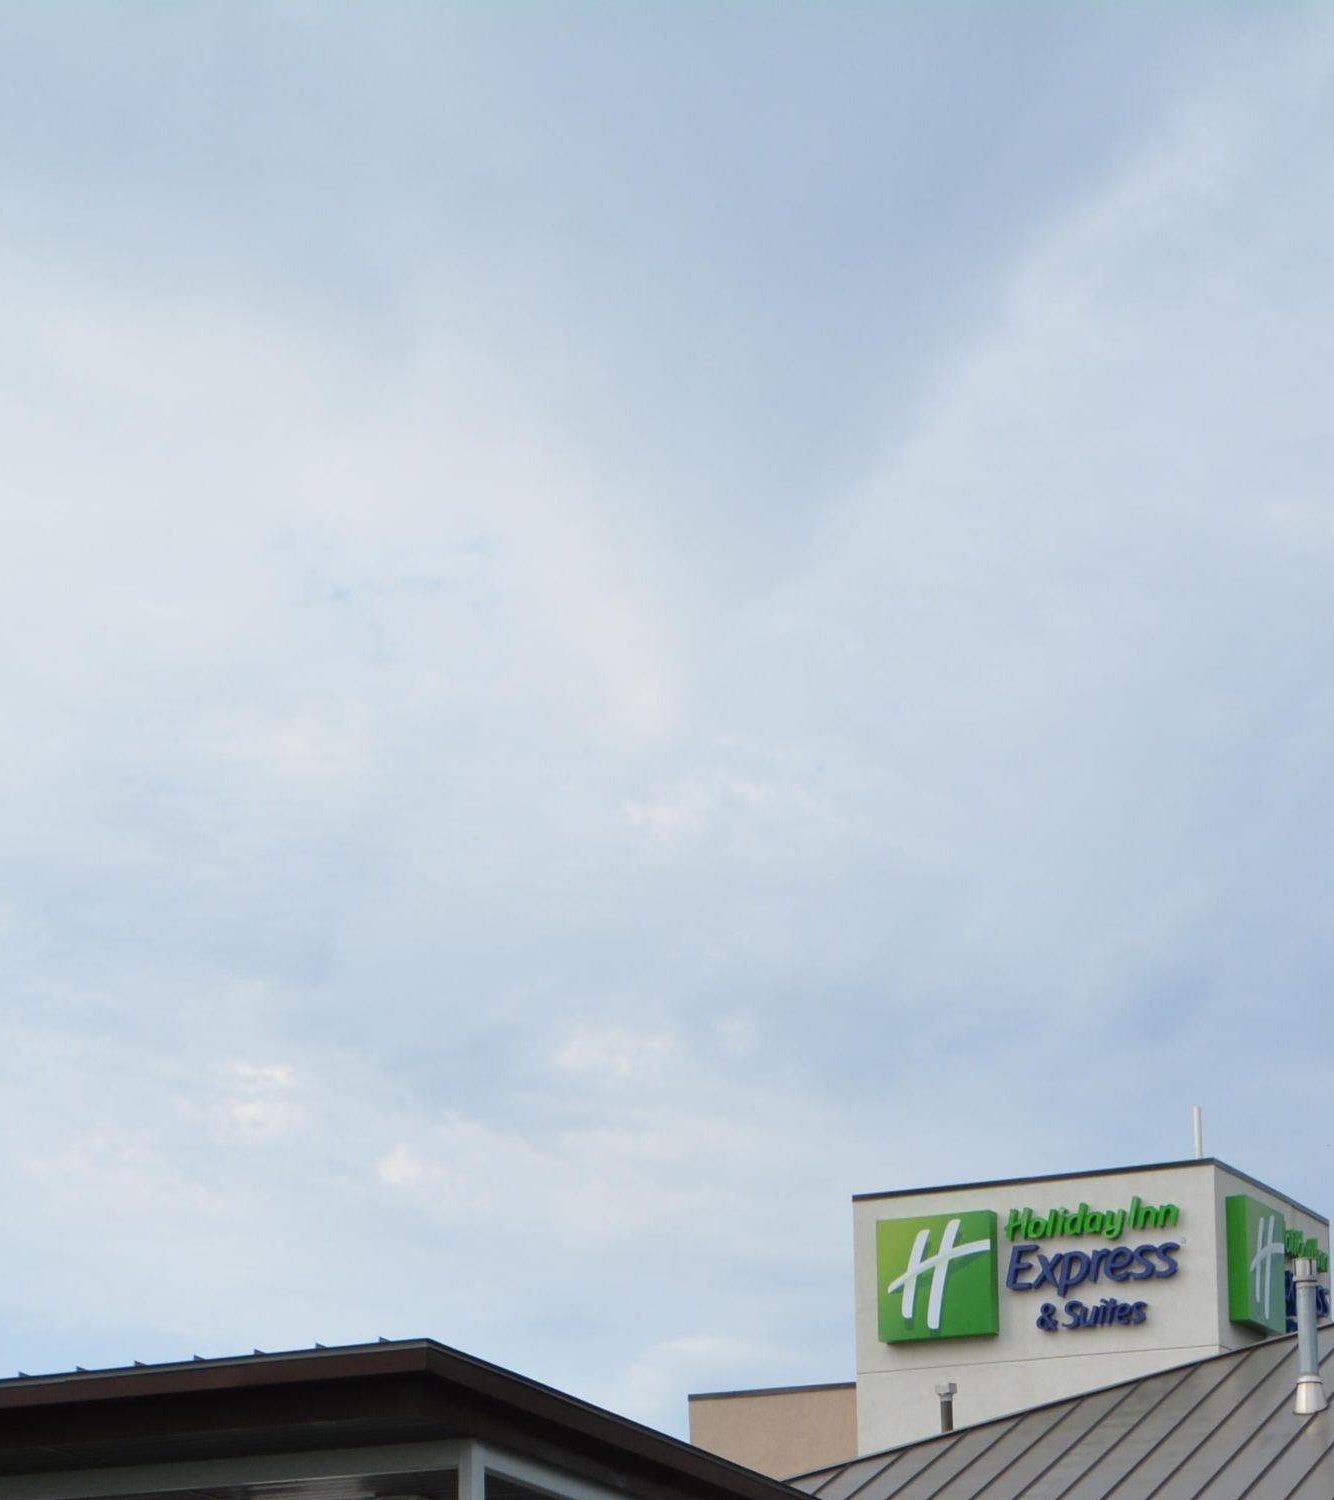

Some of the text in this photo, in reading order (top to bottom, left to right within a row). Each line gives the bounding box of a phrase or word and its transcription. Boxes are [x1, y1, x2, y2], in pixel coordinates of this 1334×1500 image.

[1005, 1196, 1179, 1242] Holiday Inn
[1006, 1242, 1180, 1298] Express
[1036, 1298, 1148, 1332] & Suites
